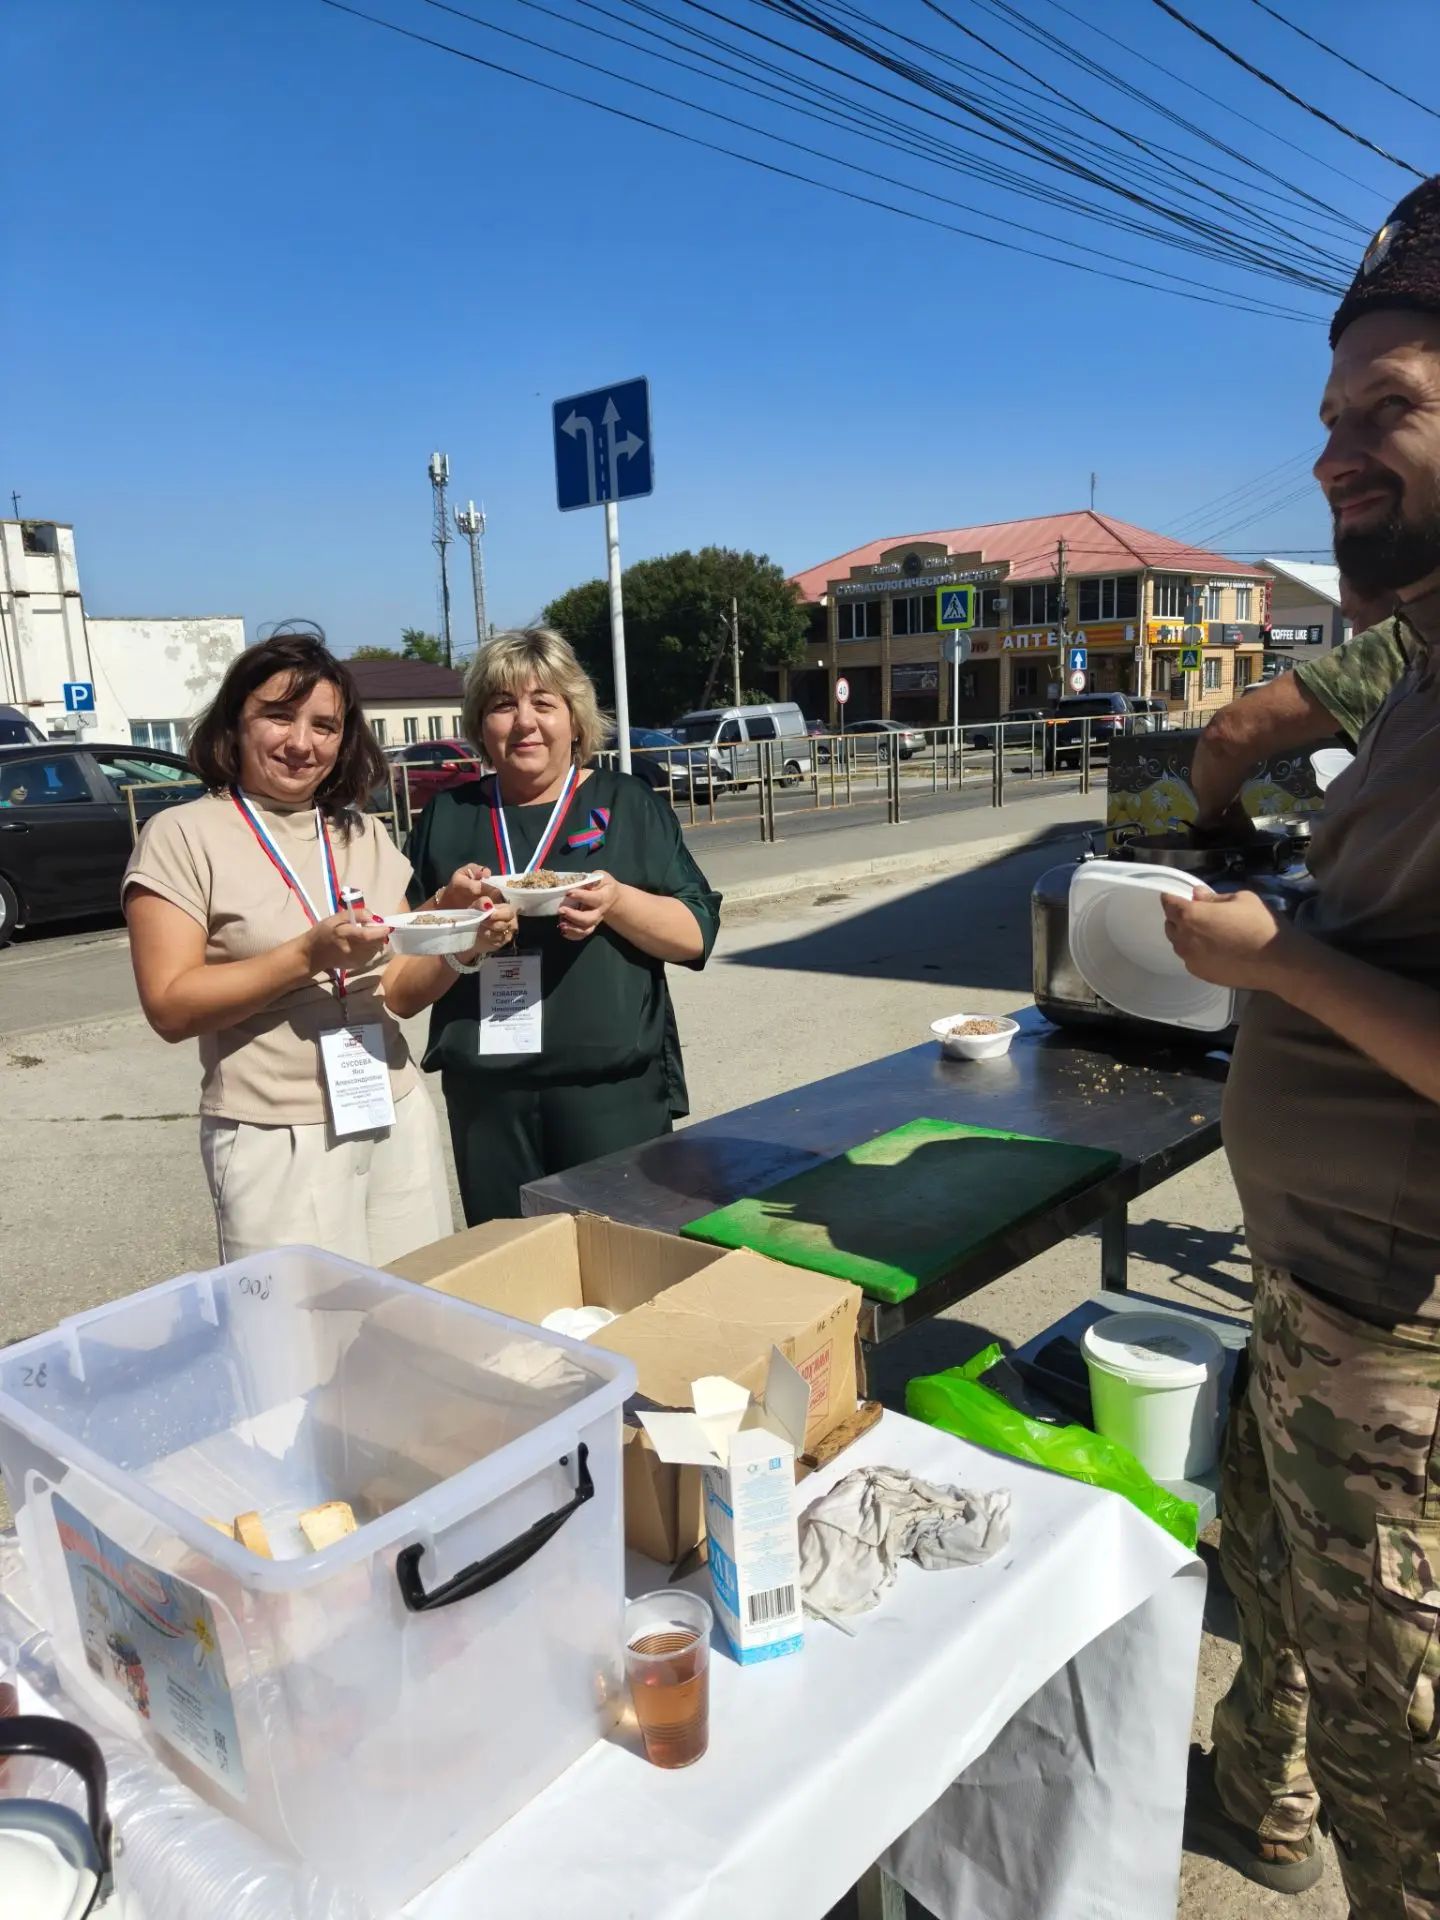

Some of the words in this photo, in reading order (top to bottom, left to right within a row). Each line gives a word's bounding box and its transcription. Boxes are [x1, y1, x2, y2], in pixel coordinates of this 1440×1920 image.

[1270, 629, 1294, 640] COFFEE
[1295, 629, 1308, 640] LIKE
[71, 685, 88, 709] P
